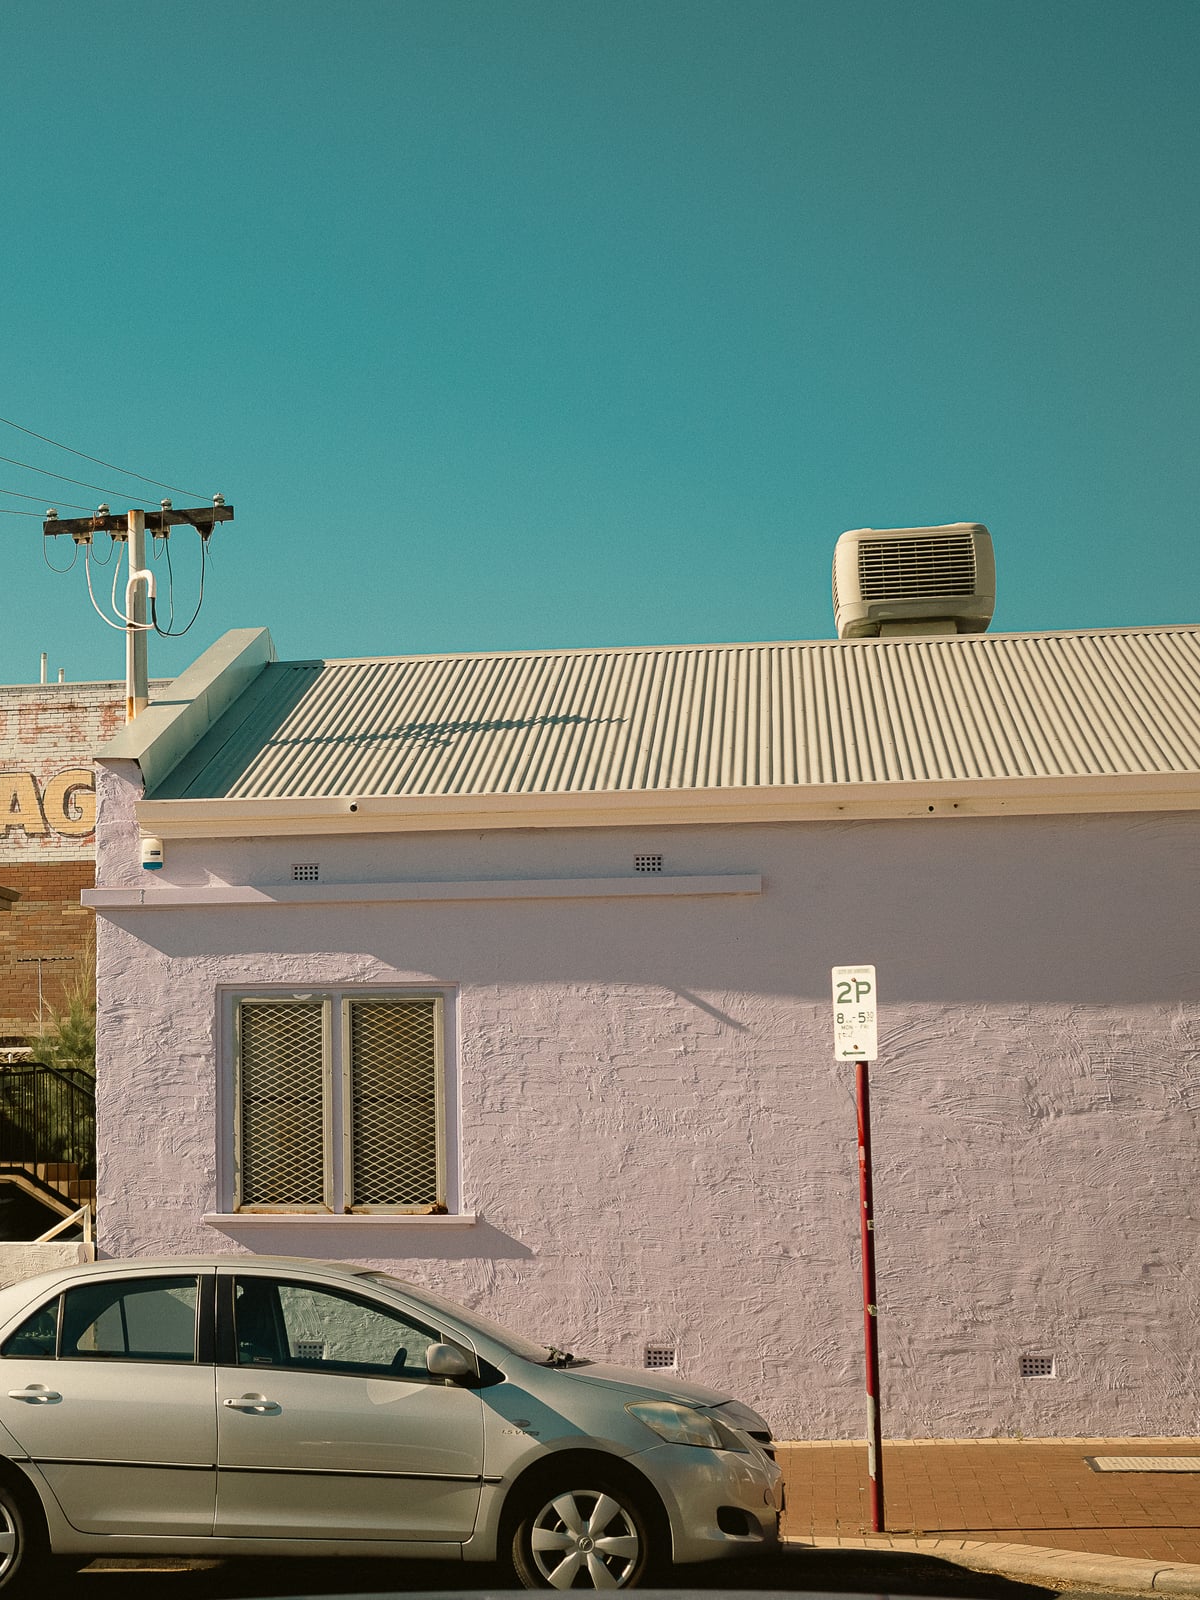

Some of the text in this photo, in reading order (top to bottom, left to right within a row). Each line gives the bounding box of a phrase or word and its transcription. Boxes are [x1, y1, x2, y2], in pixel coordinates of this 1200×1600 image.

[836, 981, 871, 1004] 2P
[836, 1012, 844, 1024] 8
[858, 1012, 866, 1023] 5
